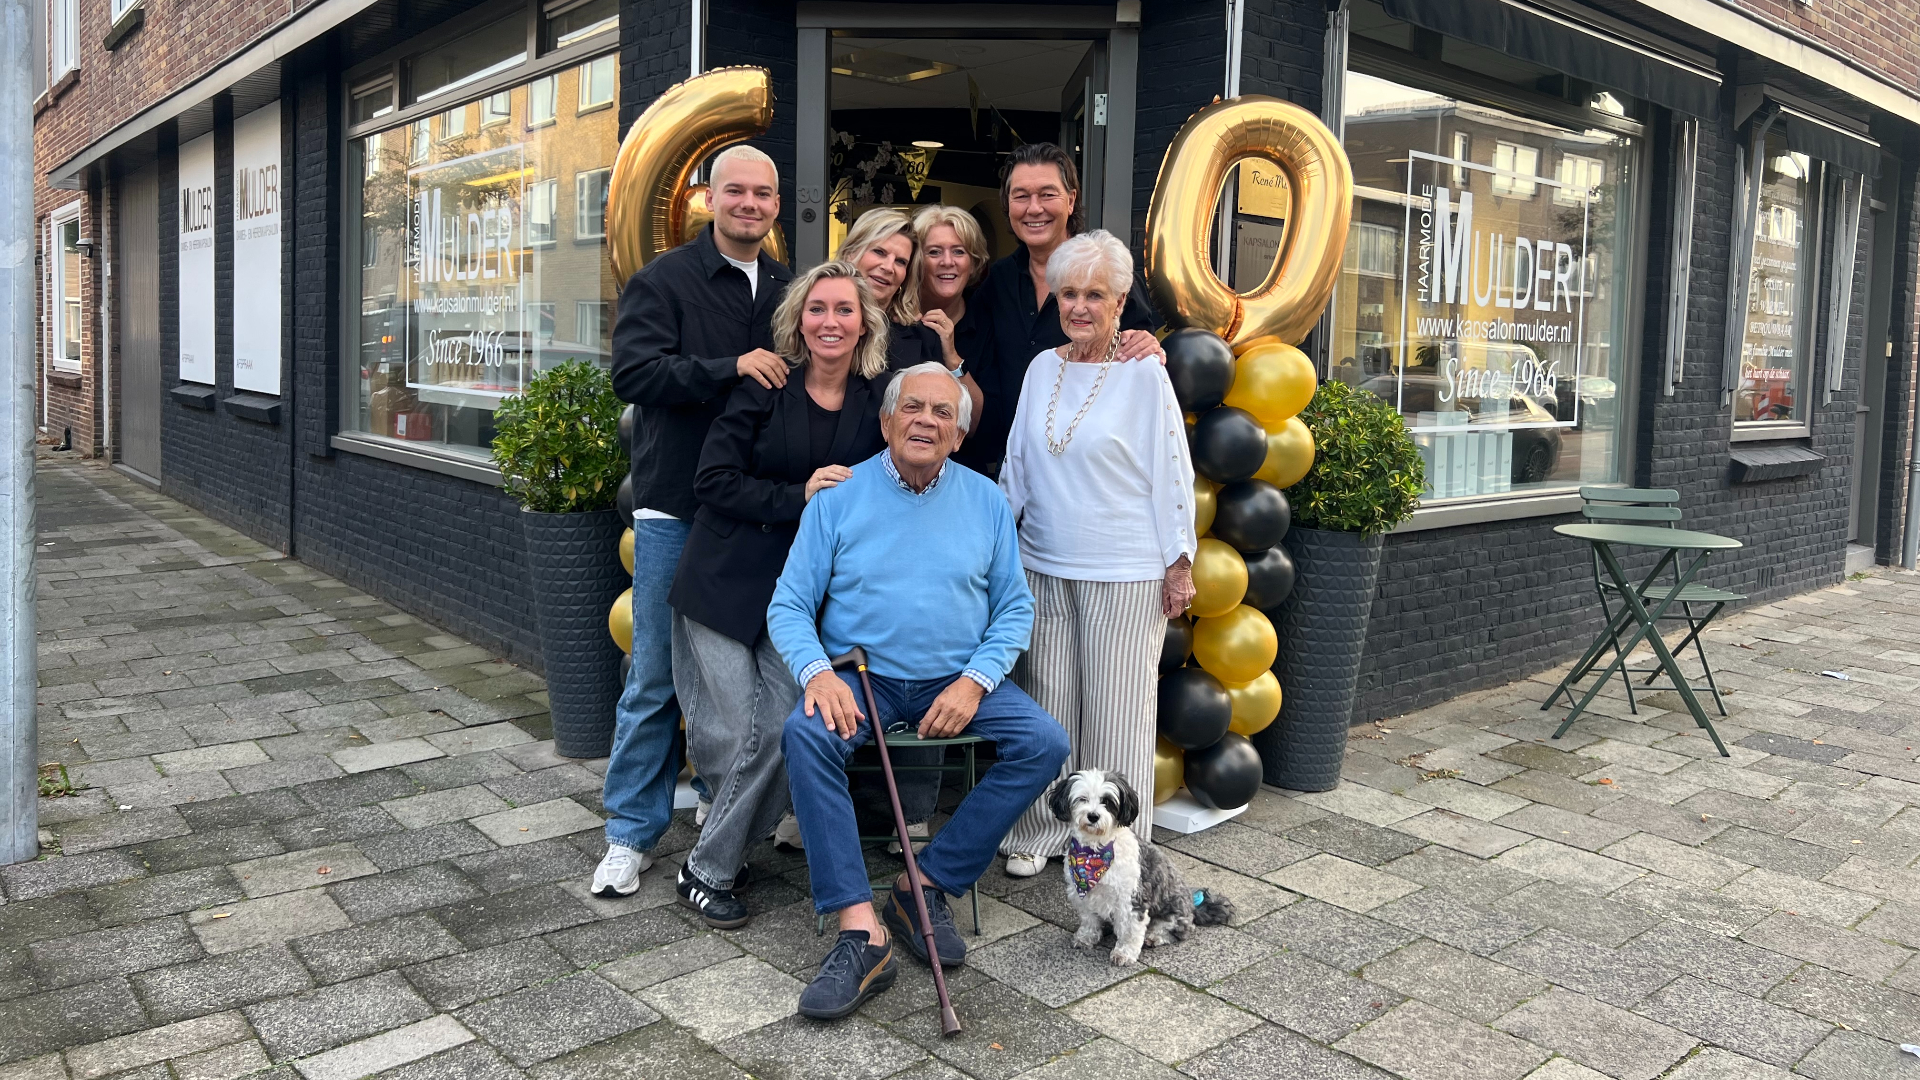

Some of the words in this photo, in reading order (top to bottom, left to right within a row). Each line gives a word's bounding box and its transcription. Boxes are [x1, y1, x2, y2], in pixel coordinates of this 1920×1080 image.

[906, 161, 925, 175] 60
[1251, 170, 1274, 188] René
[183, 186, 213, 234] MULDER
[239, 164, 278, 221] MULDER
[796, 185, 823, 204] 30
[420, 188, 513, 283] MULDER
[1243, 235, 1280, 249] KAPSALON
[1417, 184, 1433, 302] HAARMODE
[1432, 186, 1573, 313] MULDER
[413, 289, 514, 318] www.kapsalonmulder.nl
[425, 327, 463, 366] Since
[466, 329, 505, 368] 1966
[1416, 314, 1572, 343] www.kapsalonmulder.nl
[1438, 356, 1501, 403] Since
[1509, 358, 1559, 399] 1966
